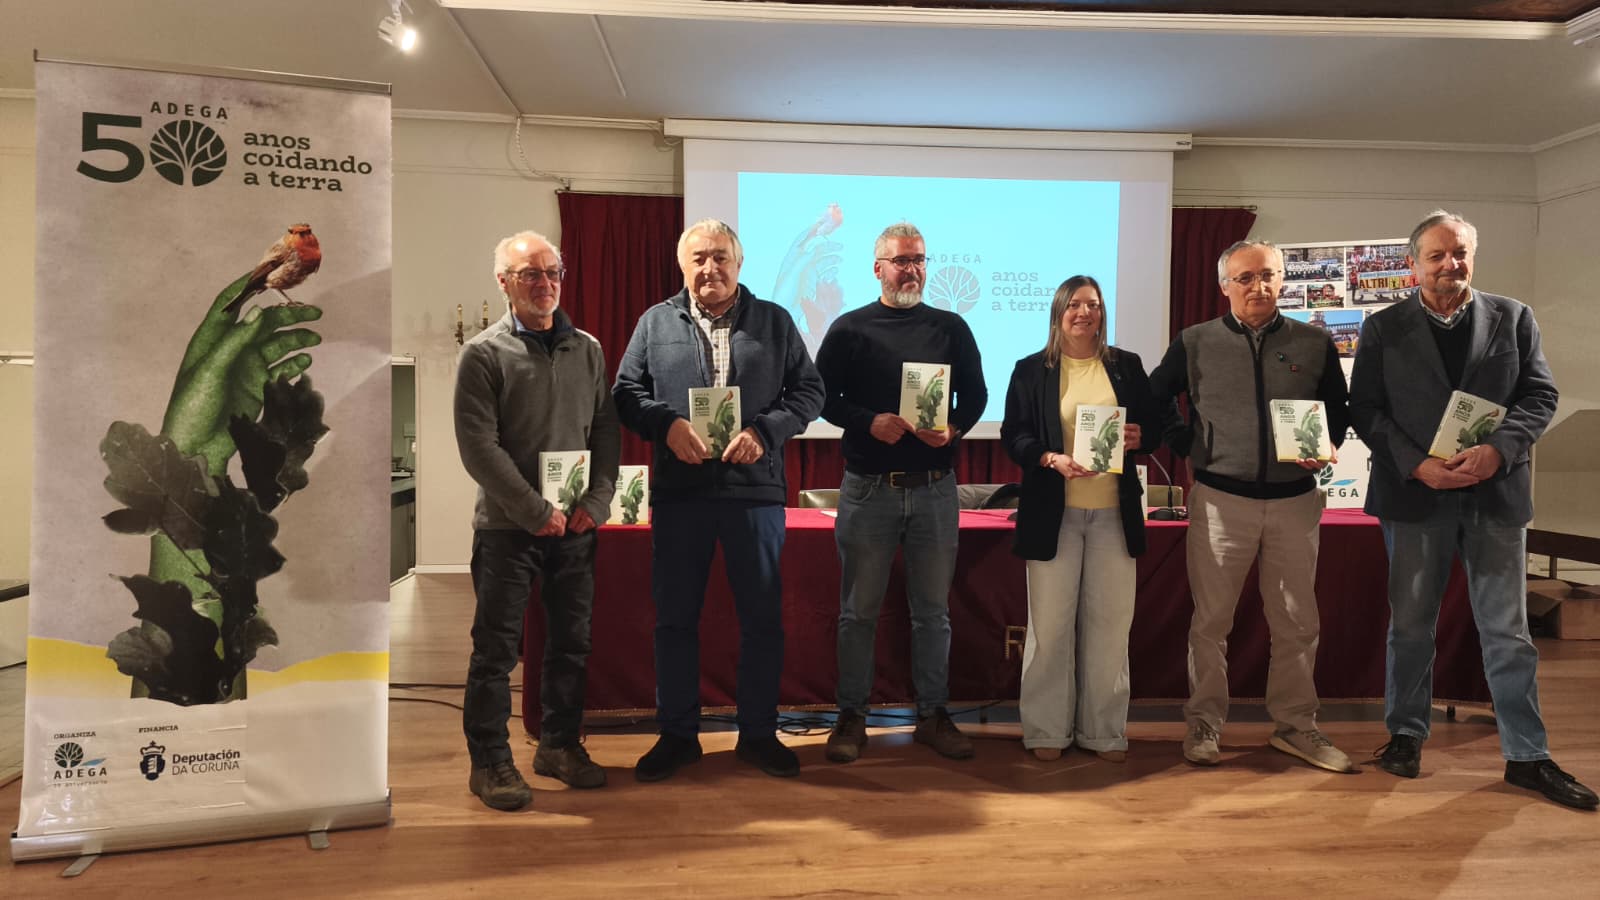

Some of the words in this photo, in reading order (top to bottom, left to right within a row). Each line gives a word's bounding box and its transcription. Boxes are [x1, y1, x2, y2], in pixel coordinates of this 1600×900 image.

[150, 101, 228, 120] ADEGA
[243, 132, 311, 150] anos
[243, 150, 372, 175] coidando
[243, 171, 259, 185] a
[269, 172, 343, 191] terra
[930, 254, 982, 264] ADEGA
[991, 271, 1039, 282] anos
[991, 283, 1056, 297] coidan
[1359, 278, 1388, 289] ALTRI
[991, 301, 1002, 311] a
[1009, 299, 1049, 312] terr
[1327, 488, 1360, 498] EGA
[53, 731, 97, 739] ORGANIZA
[138, 725, 179, 733] FINANCIA
[172, 749, 241, 765] Deputación
[53, 767, 108, 780] ADEGA
[171, 766, 188, 776] DA
[191, 761, 241, 775] CORUÑA
